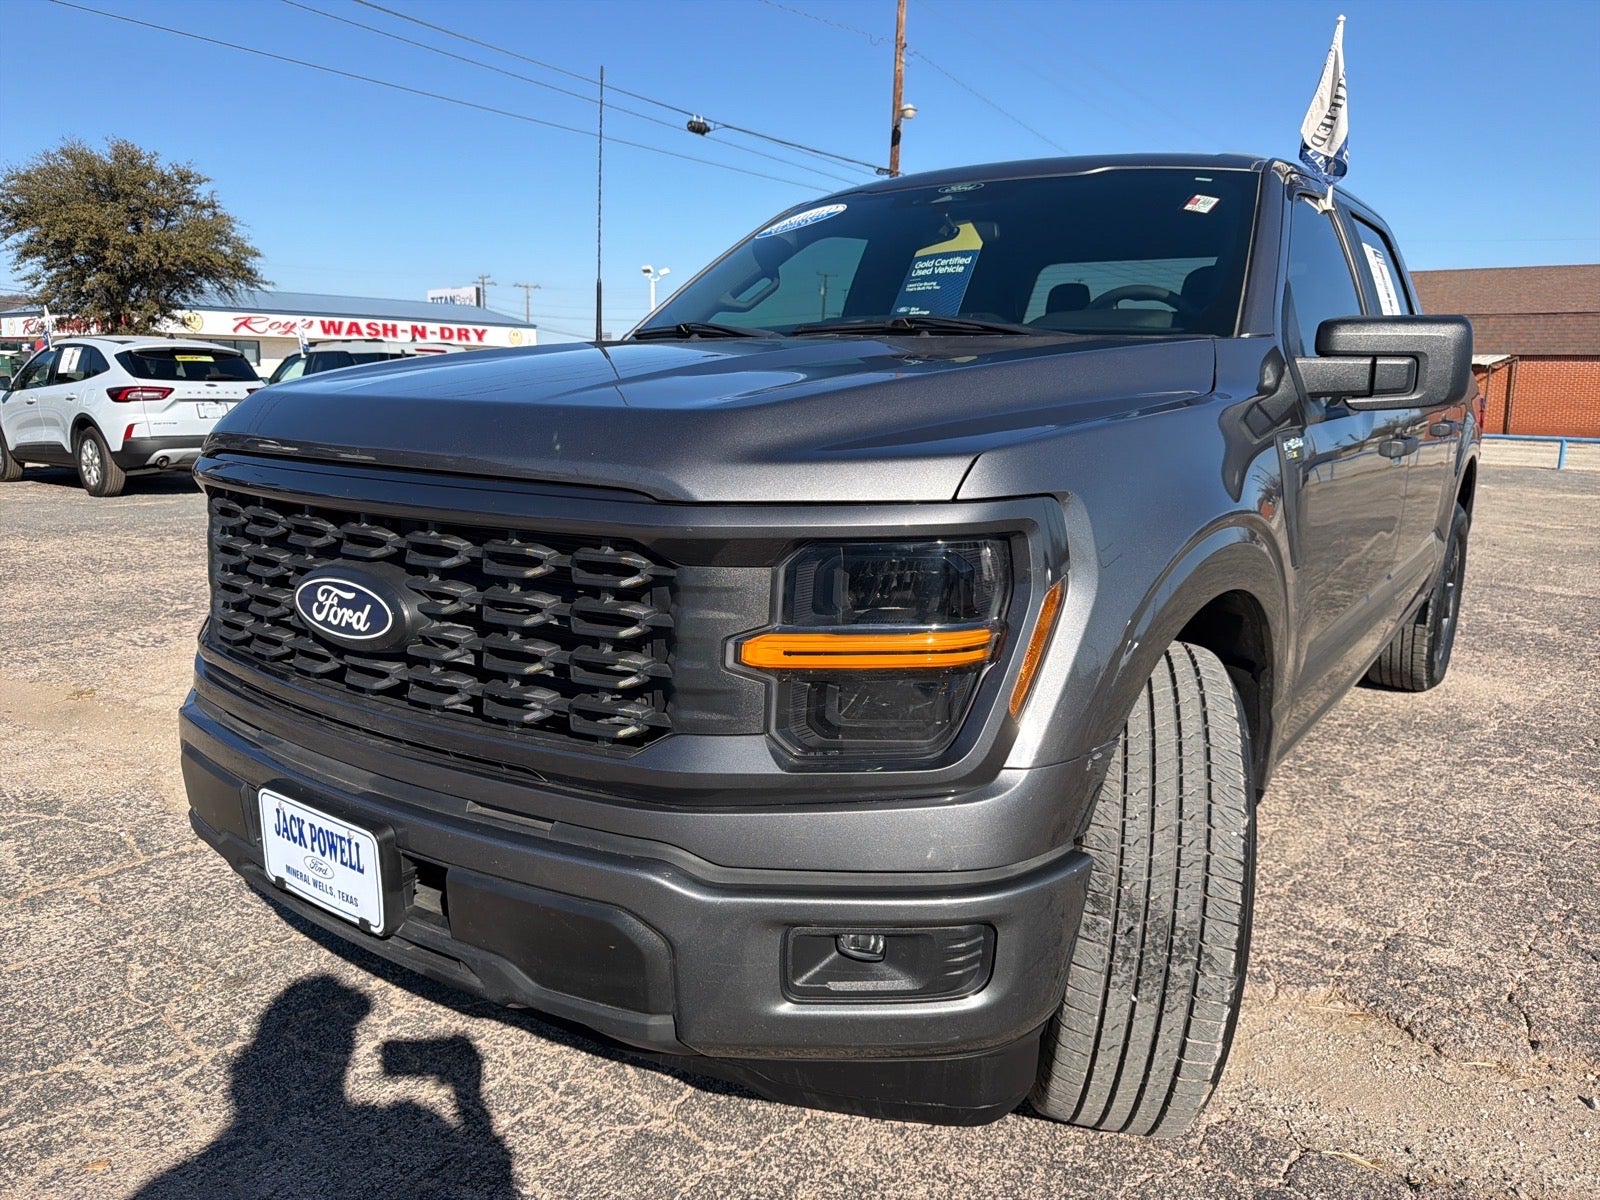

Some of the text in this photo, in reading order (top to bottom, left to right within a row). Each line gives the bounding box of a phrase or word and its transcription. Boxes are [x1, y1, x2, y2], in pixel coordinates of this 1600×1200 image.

[911, 265, 965, 277] Used Vehicle
[914, 256, 972, 269] Gold Certified
[232, 316, 488, 342] Roy's WASH-N-DRY
[312, 584, 372, 632] Ford
[274, 808, 365, 875] JACK POWELL
[309, 858, 329, 877] Ford
[285, 864, 359, 908] MINERAL WELLS, TEXAS
